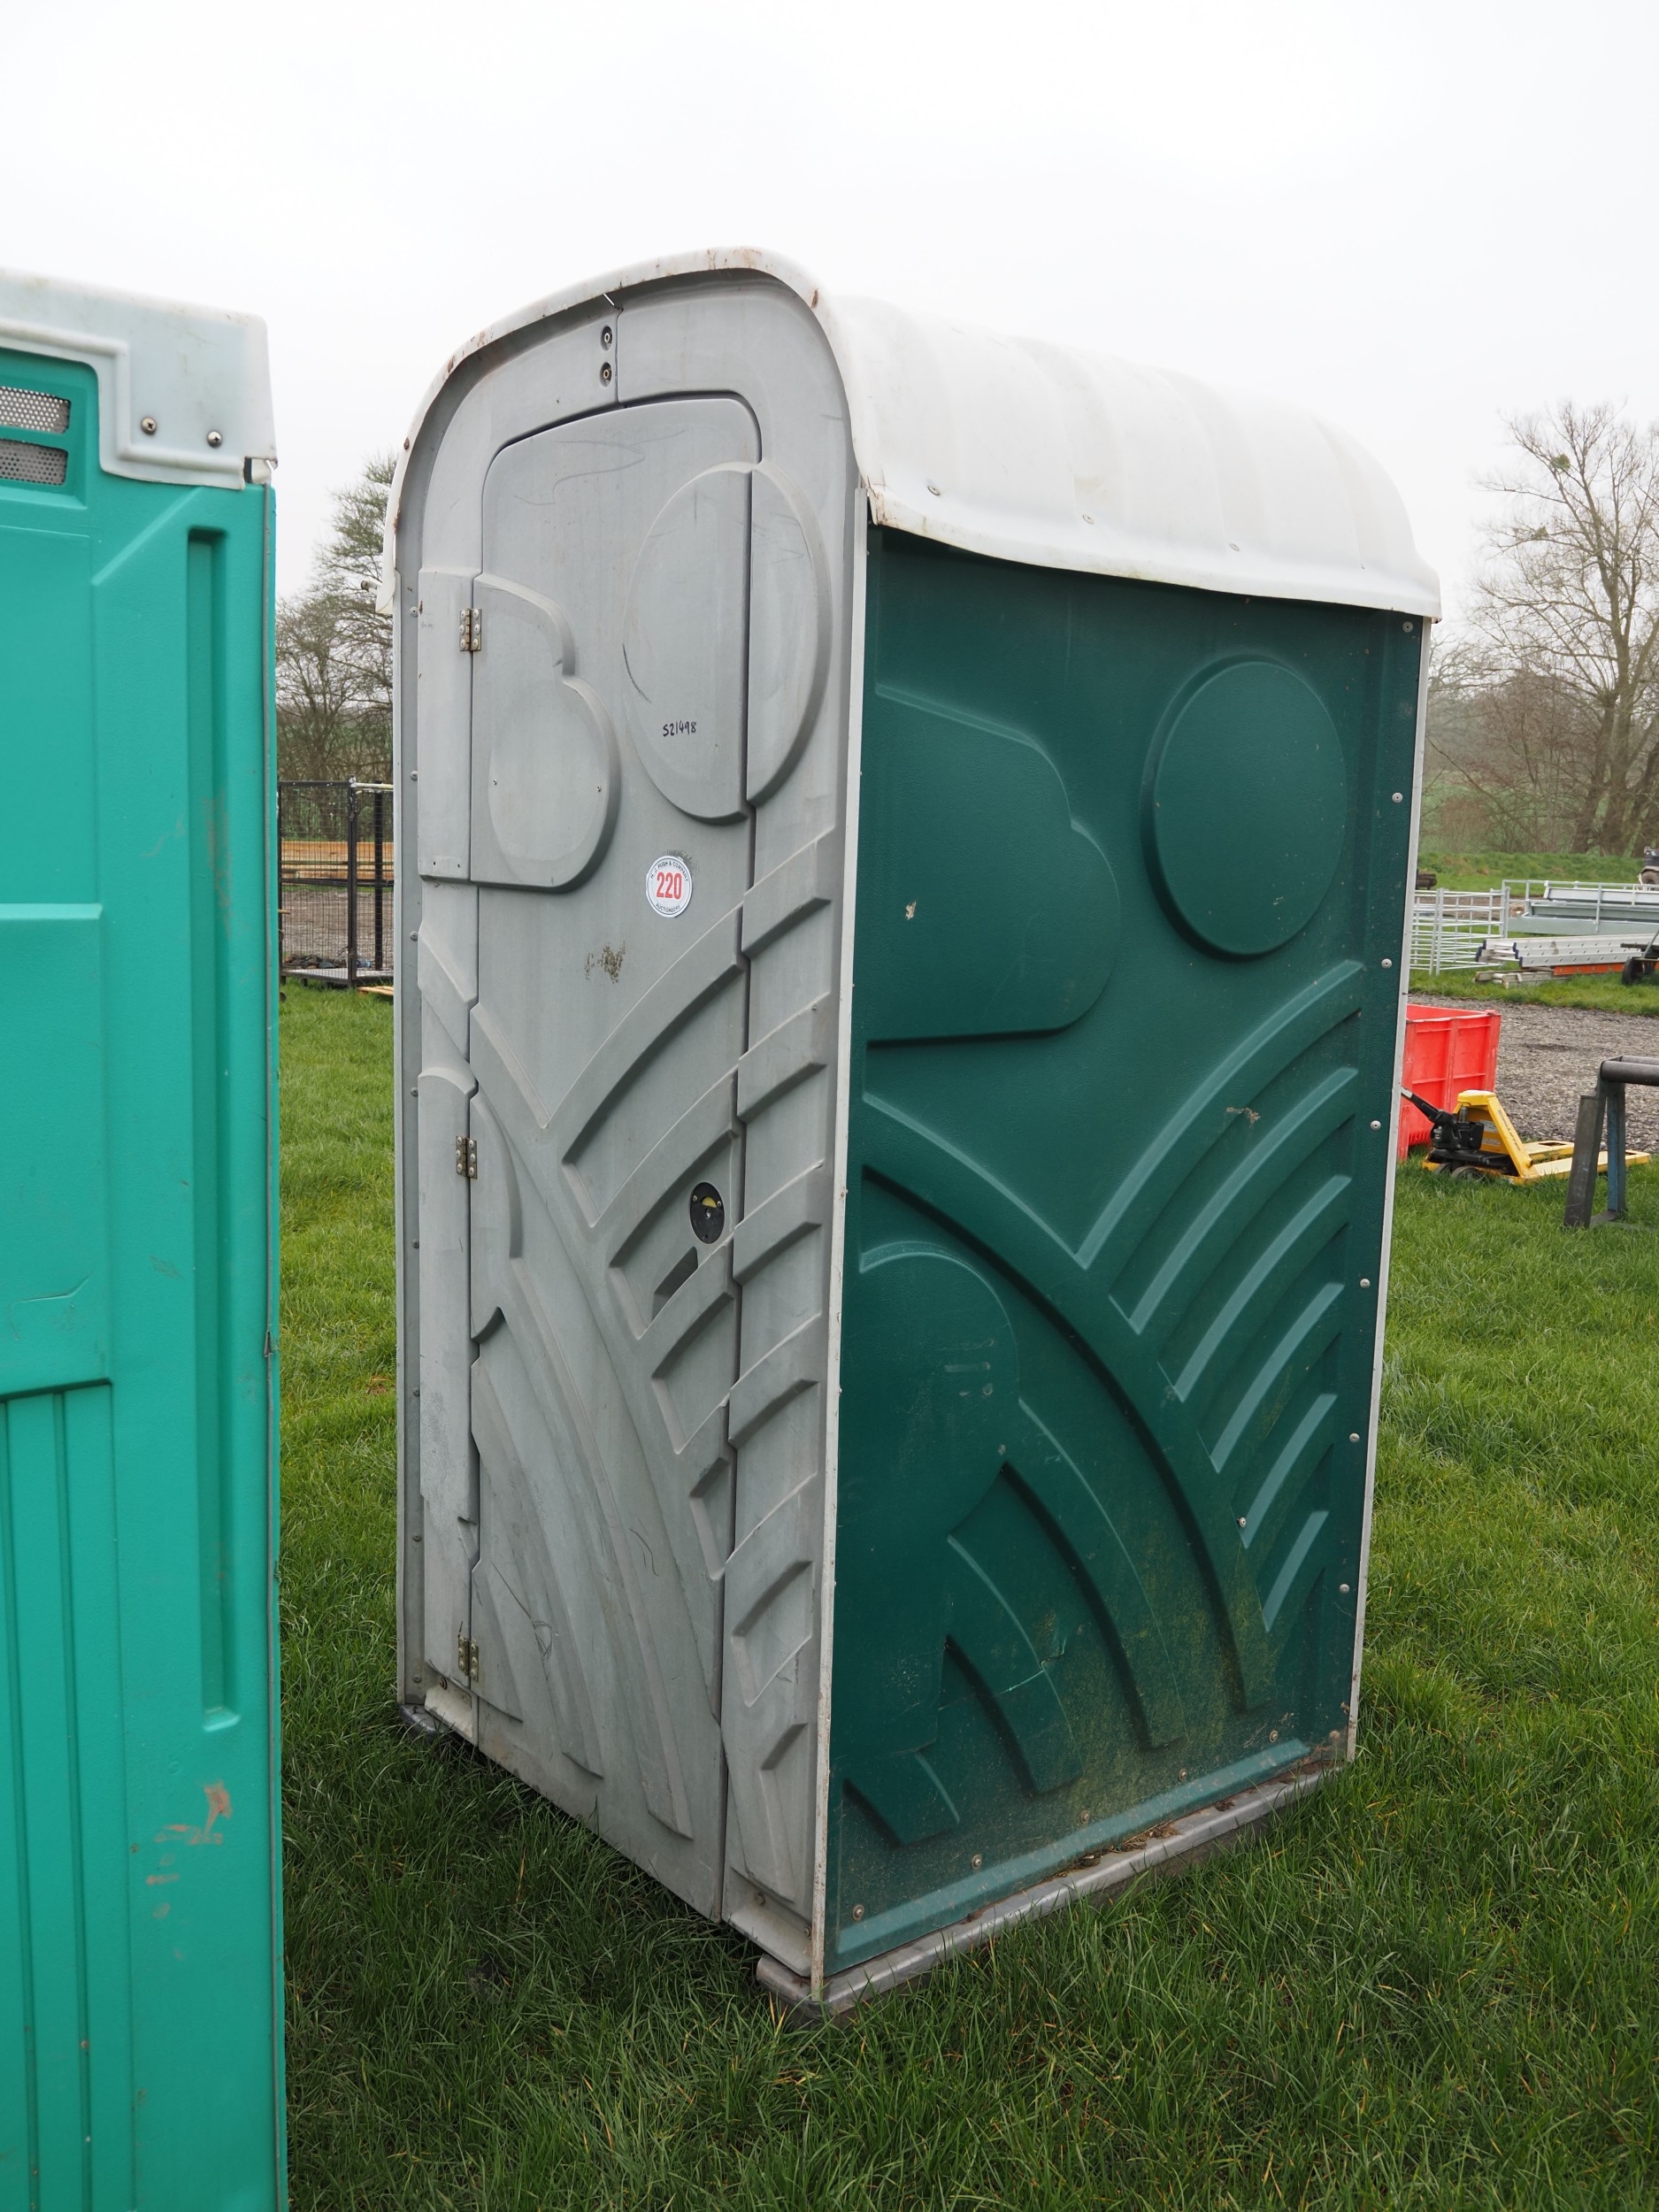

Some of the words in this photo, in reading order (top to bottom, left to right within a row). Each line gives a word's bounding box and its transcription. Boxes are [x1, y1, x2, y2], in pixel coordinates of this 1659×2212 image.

[672, 861, 688, 881] COMPANY
[657, 872, 682, 900] 220
[656, 902, 680, 913] AUCTIONEERS
